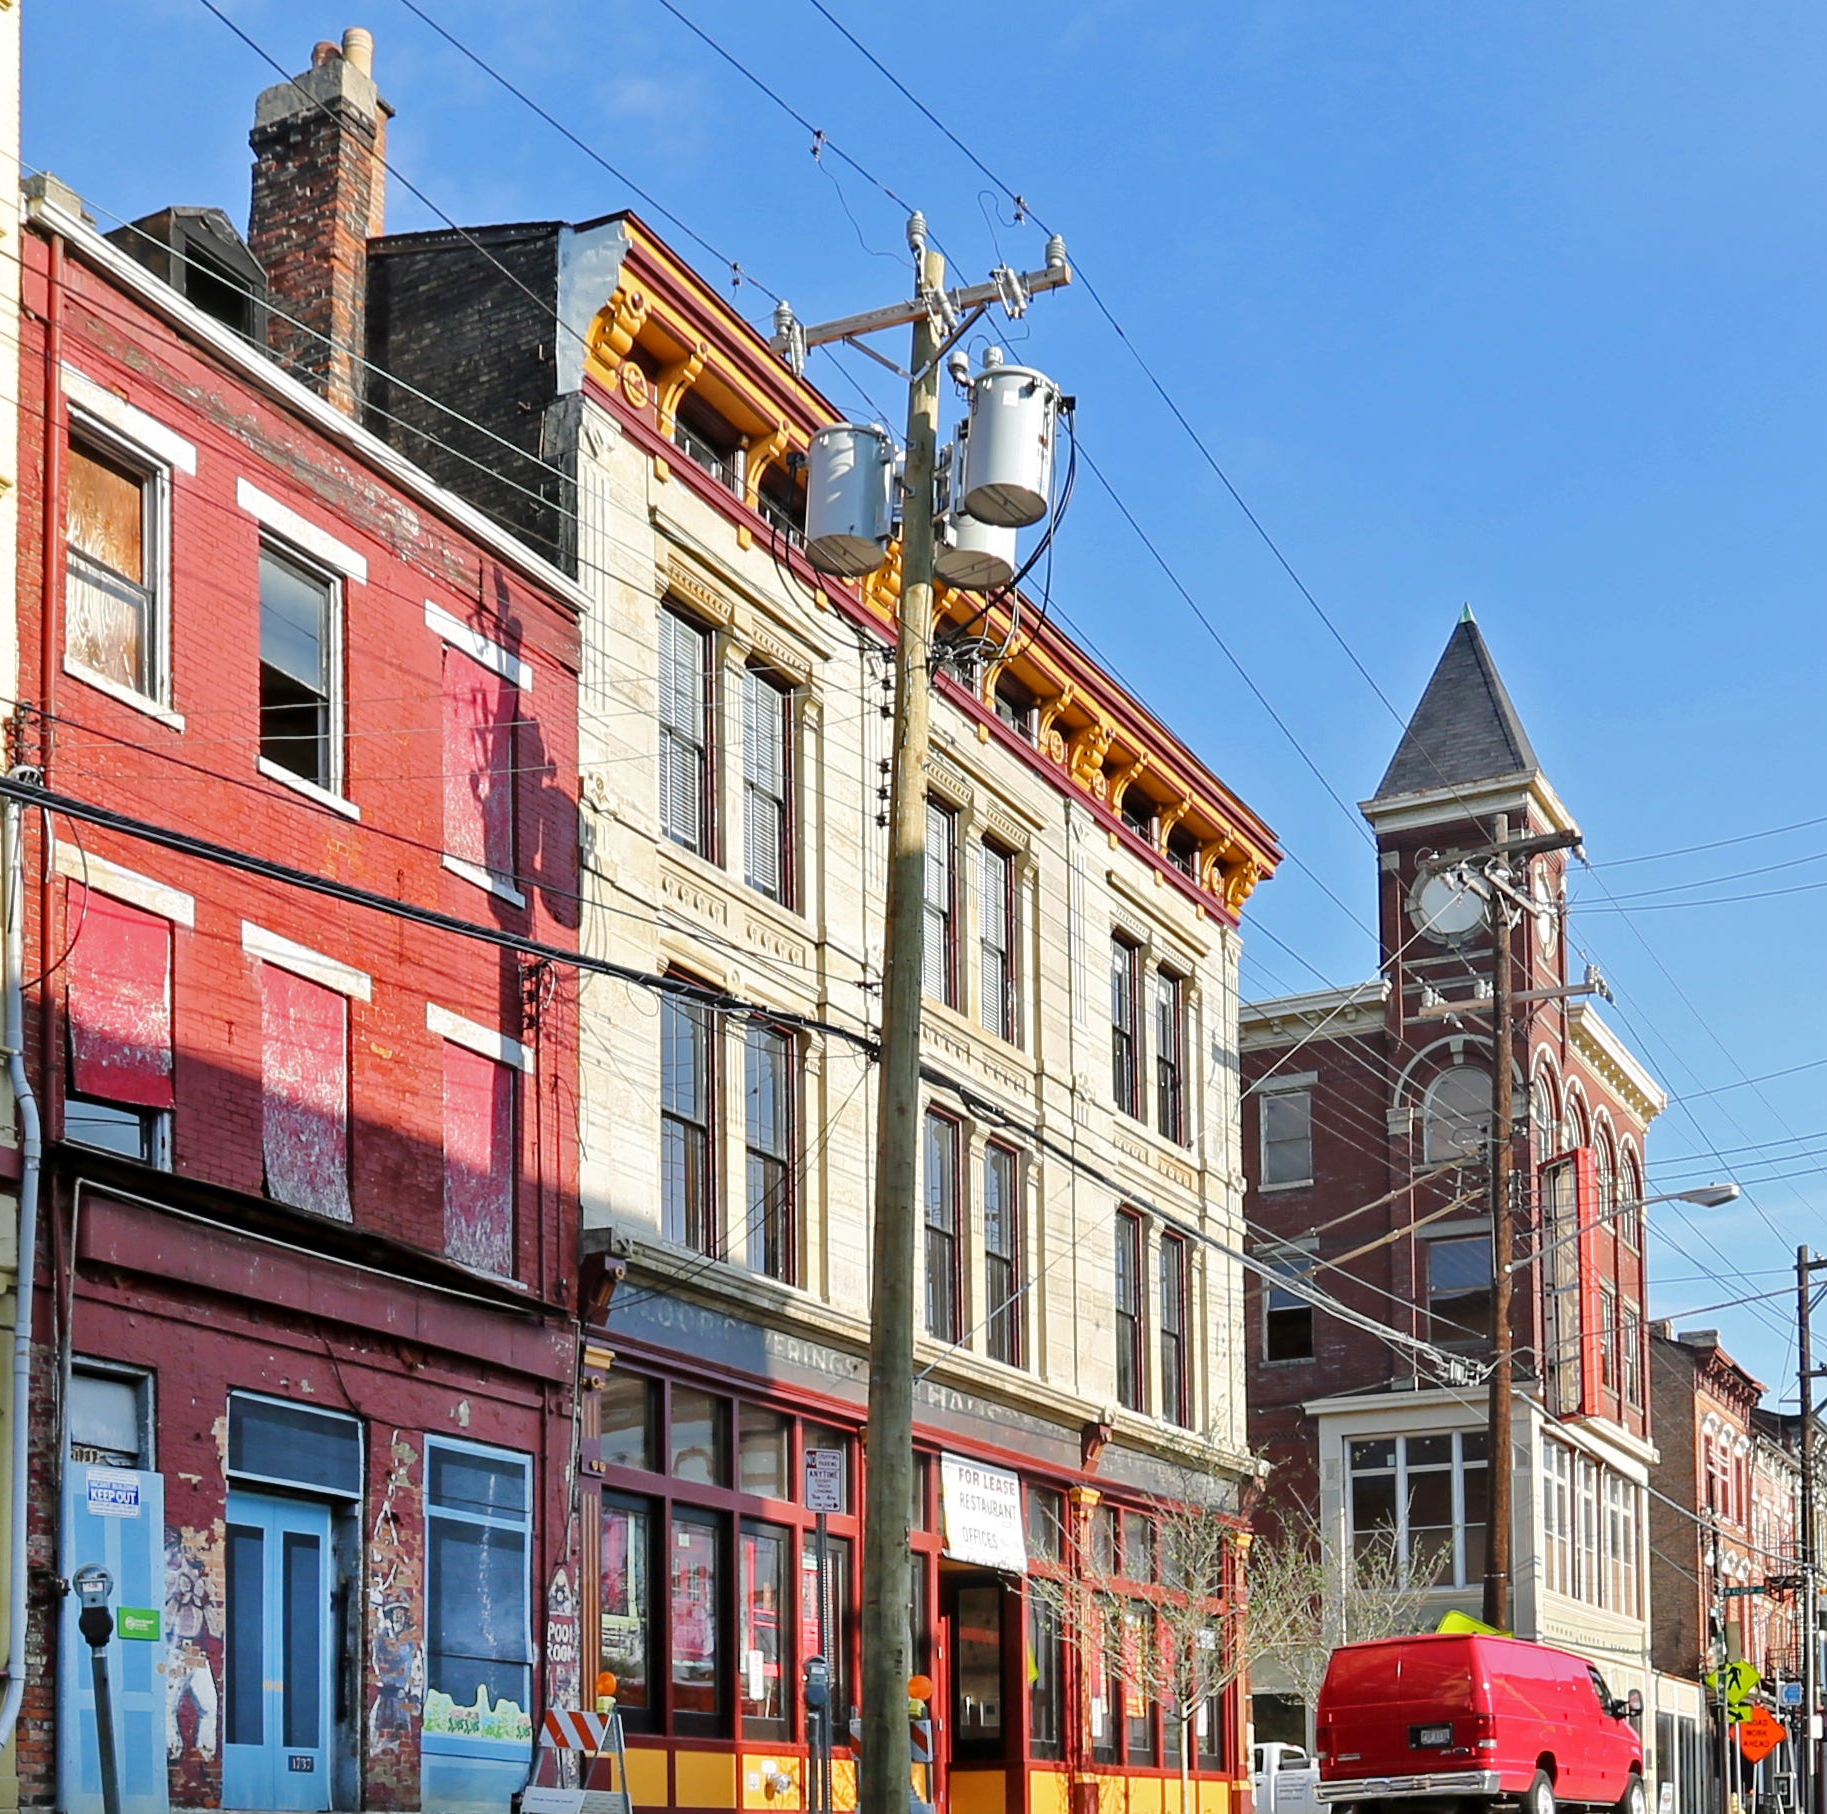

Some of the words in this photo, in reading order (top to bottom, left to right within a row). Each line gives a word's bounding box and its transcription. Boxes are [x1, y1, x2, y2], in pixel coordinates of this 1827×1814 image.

[806, 1454, 816, 1465] NO
[809, 1470, 838, 1479] ANYTIME
[959, 1467, 980, 1487] FOR
[983, 1473, 1016, 1496] LEASE
[90, 1488, 115, 1501] KEEP
[116, 1491, 136, 1505] OUT
[959, 1492, 1016, 1521] RESTAURANT
[962, 1525, 998, 1551] OFFICES
[292, 1757, 312, 1770] 1737
